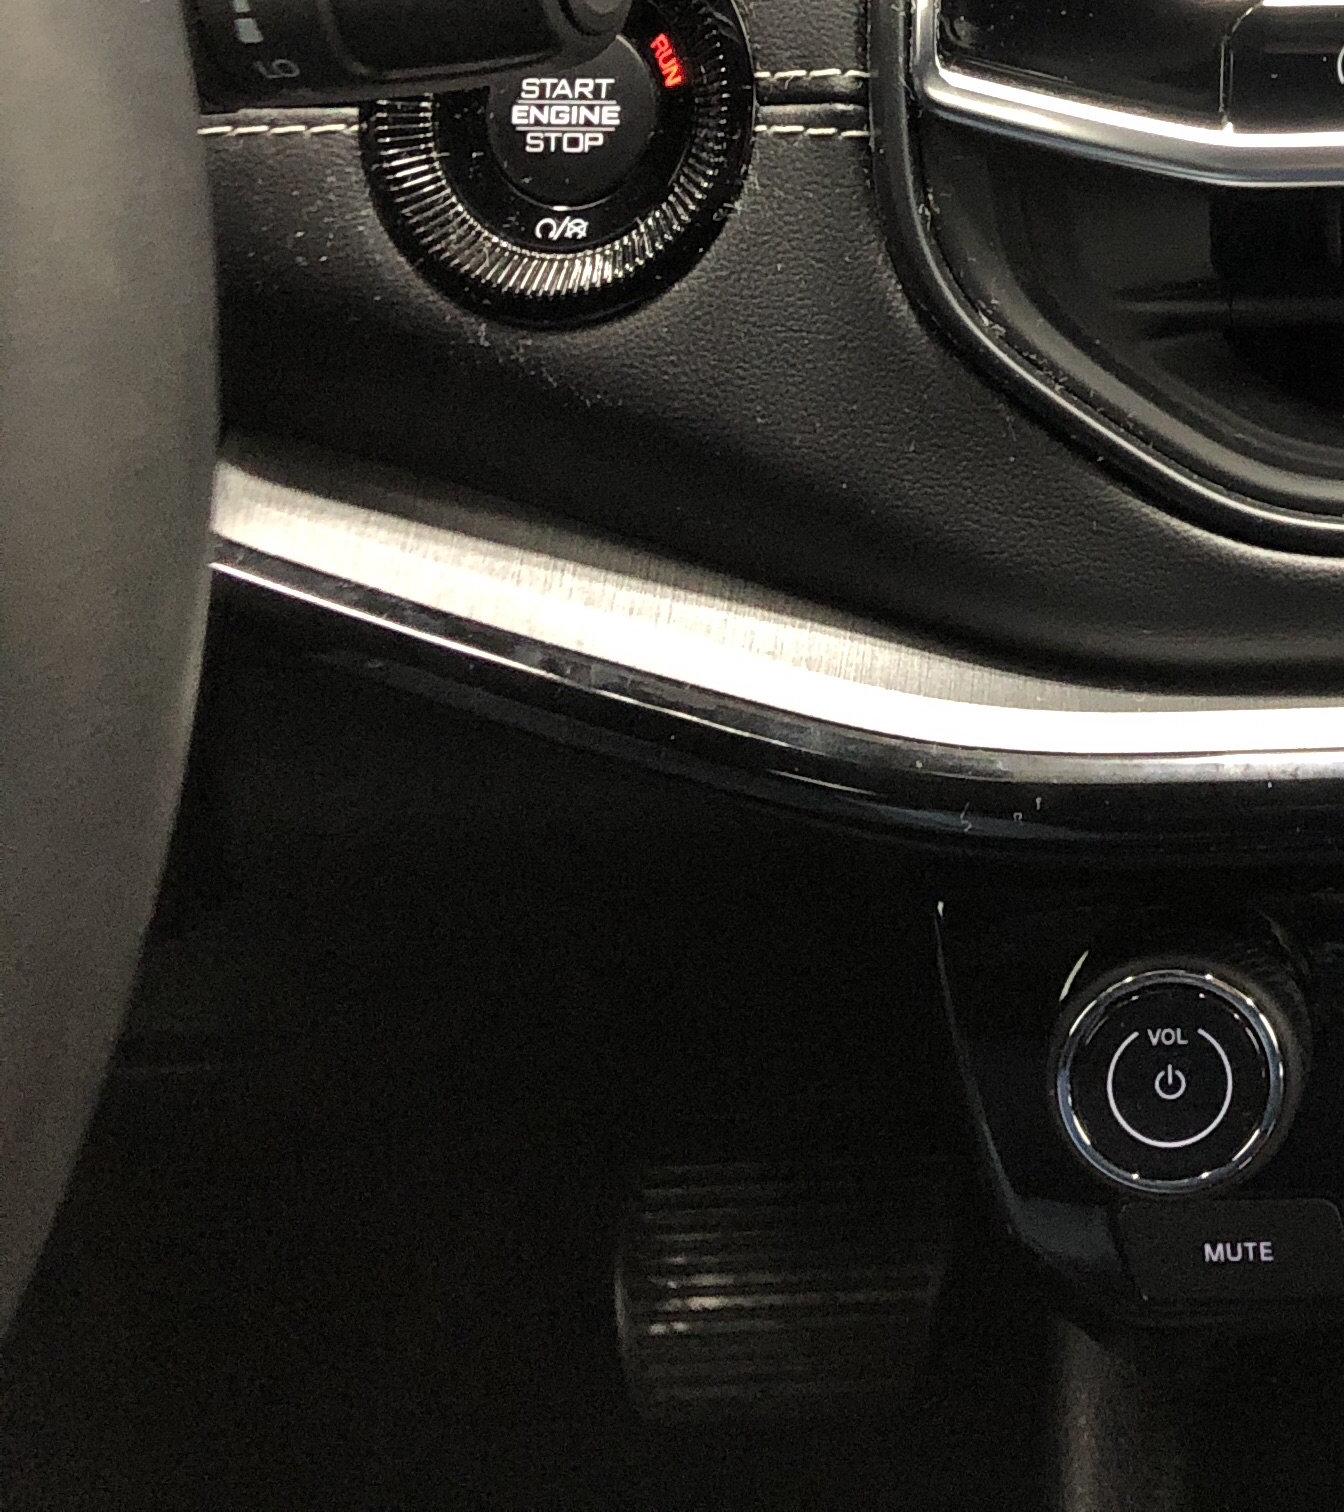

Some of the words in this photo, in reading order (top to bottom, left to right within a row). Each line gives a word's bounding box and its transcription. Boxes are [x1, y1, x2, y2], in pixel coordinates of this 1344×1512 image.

[650, 33, 684, 88] RUN
[520, 77, 616, 99] START
[511, 104, 621, 125] ENGINE
[525, 131, 604, 154] STOP
[1147, 1027, 1188, 1046] VOL
[1203, 1241, 1274, 1264] MUTE
